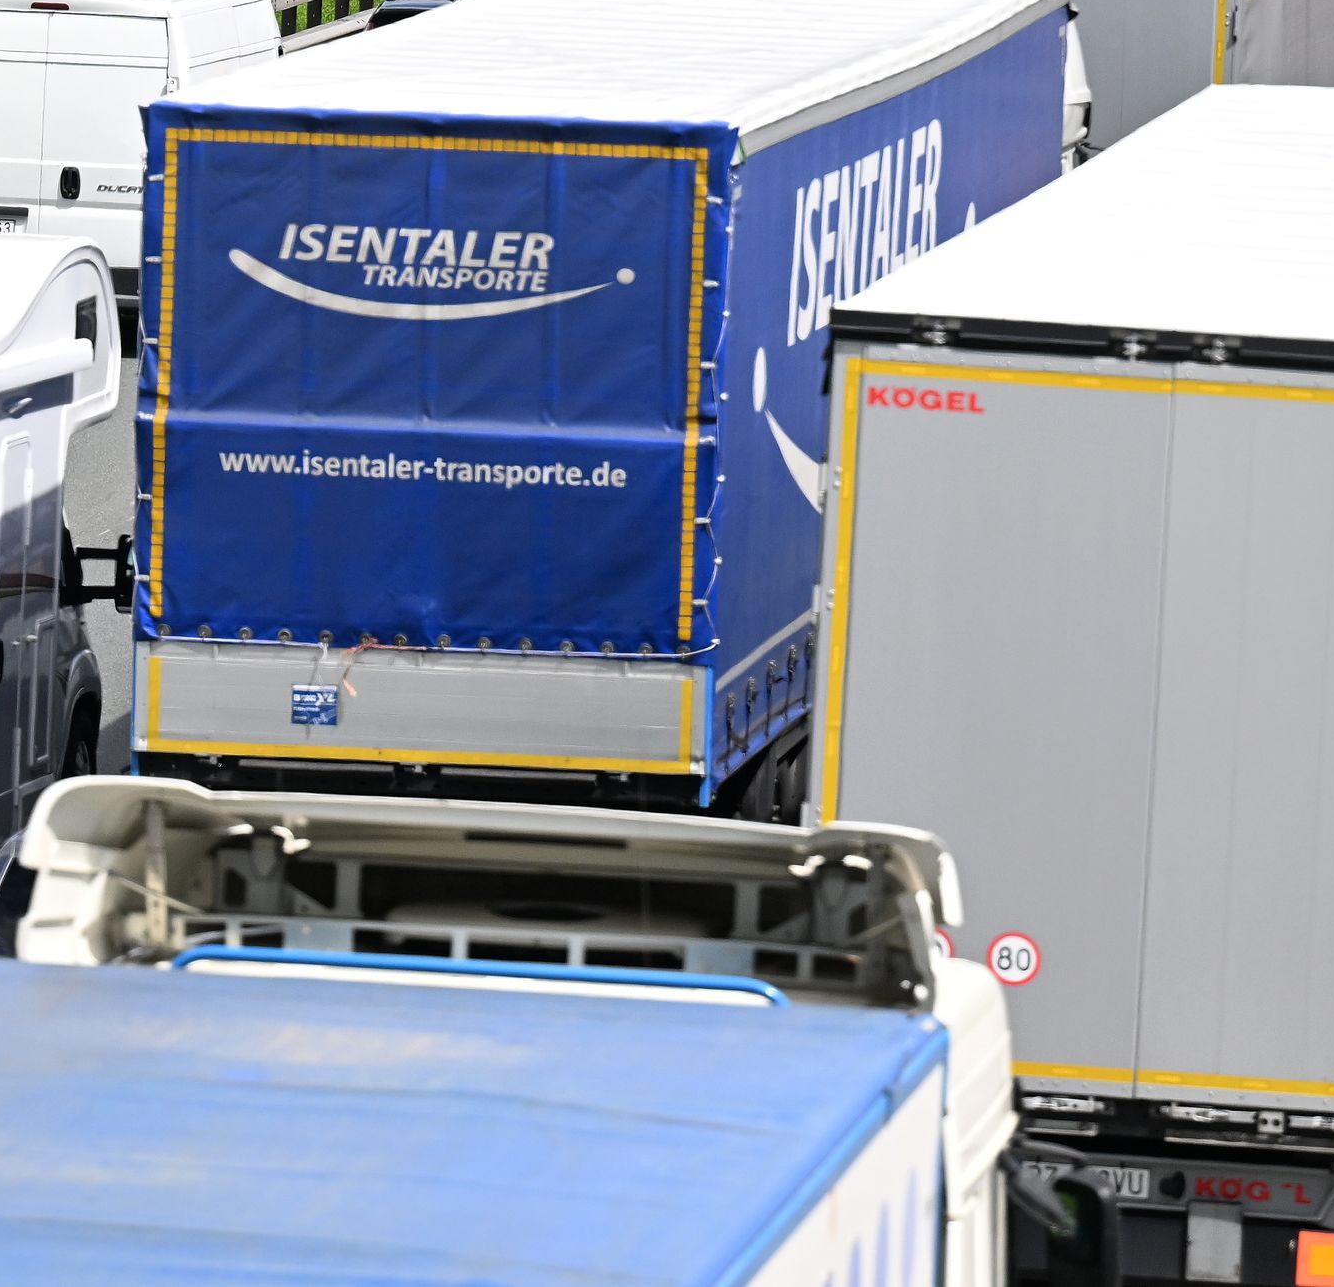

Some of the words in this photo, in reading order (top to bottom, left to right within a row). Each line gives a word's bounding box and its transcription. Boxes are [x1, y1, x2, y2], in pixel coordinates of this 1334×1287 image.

[97, 184, 143, 194] DUCAT
[278, 222, 555, 271] ISENTALER
[787, 118, 943, 347] ISENTALER
[362, 264, 549, 293] TRANSPORTE
[867, 385, 986, 414] KÖGEL
[219, 449, 628, 489] www.isentaler-transporte.de
[997, 946, 1031, 971] 80
[1194, 1176, 1312, 1206] KÖGL
